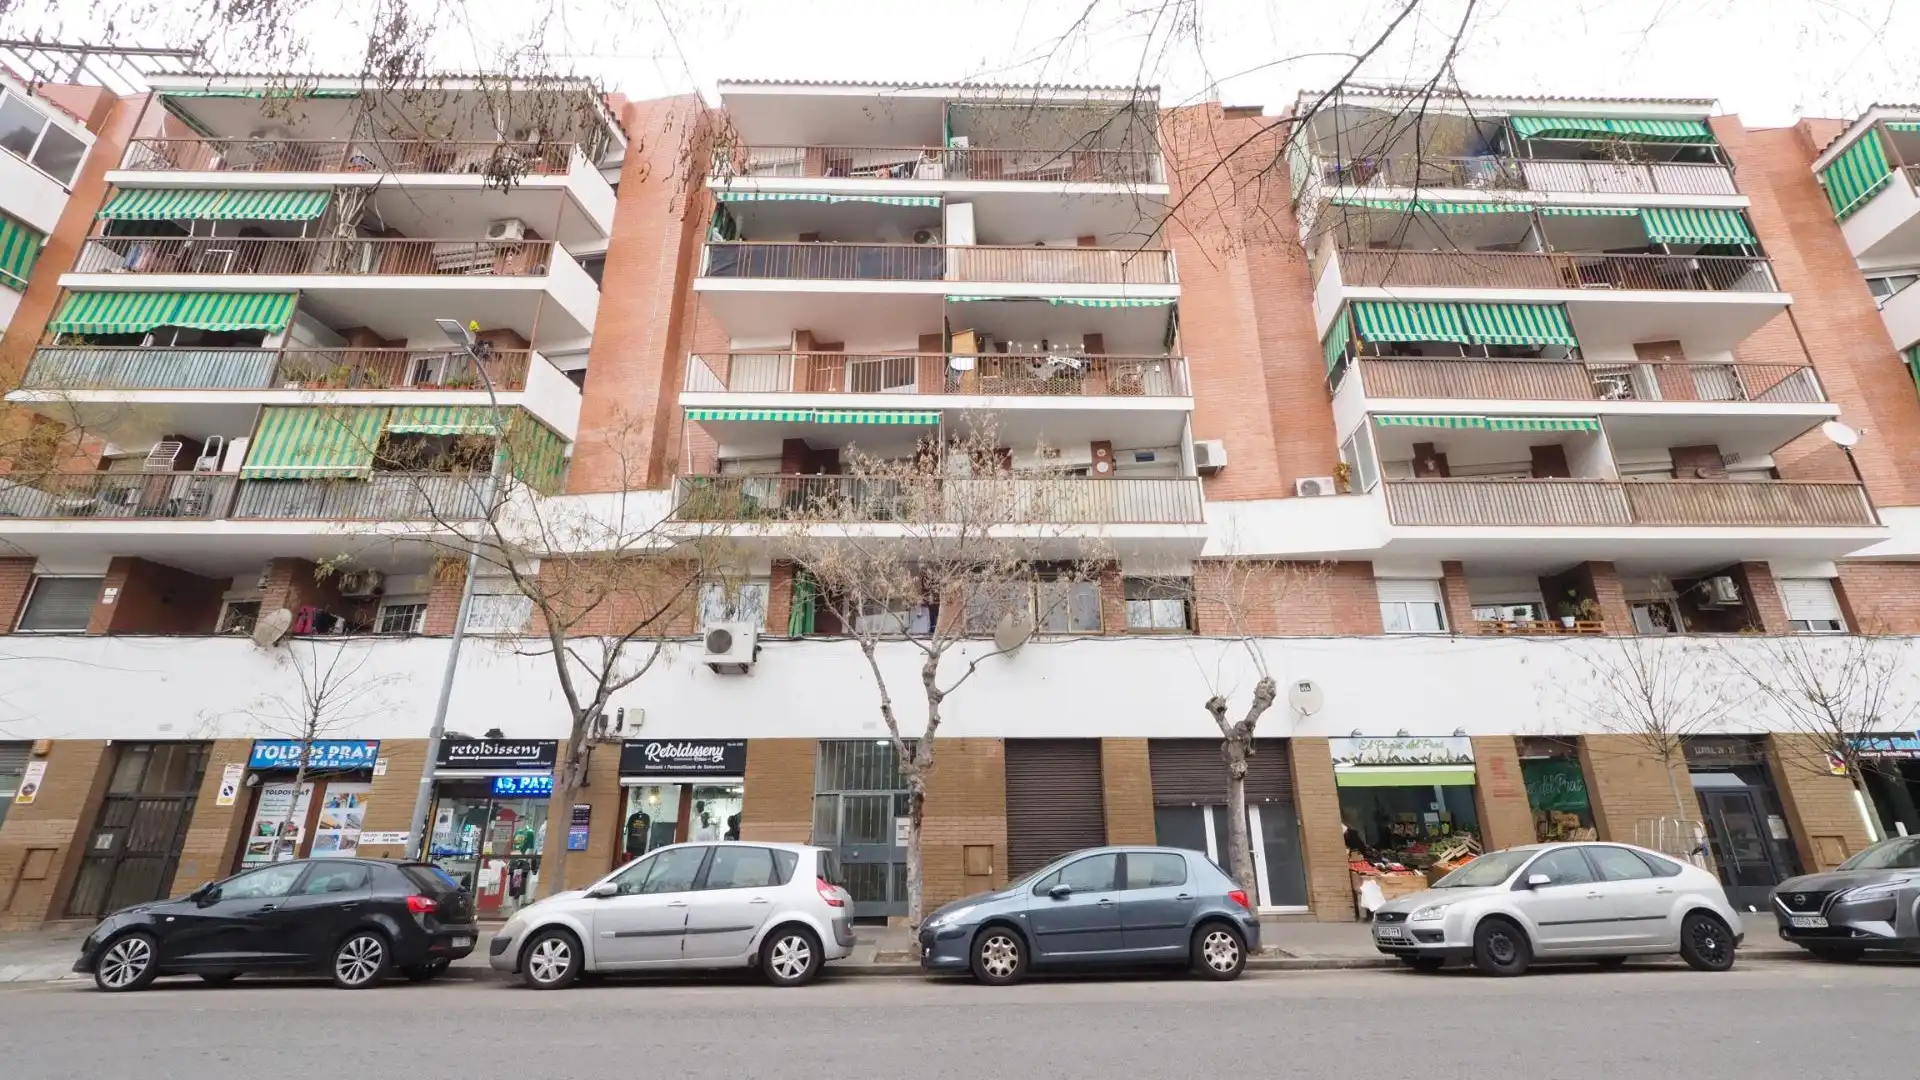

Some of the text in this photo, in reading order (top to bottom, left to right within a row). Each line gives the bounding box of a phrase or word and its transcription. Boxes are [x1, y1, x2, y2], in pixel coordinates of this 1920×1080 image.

[327, 745, 376, 760] PRAT
[450, 742, 541, 759] retoldisseny
[644, 742, 724, 763] Retoldisseny
